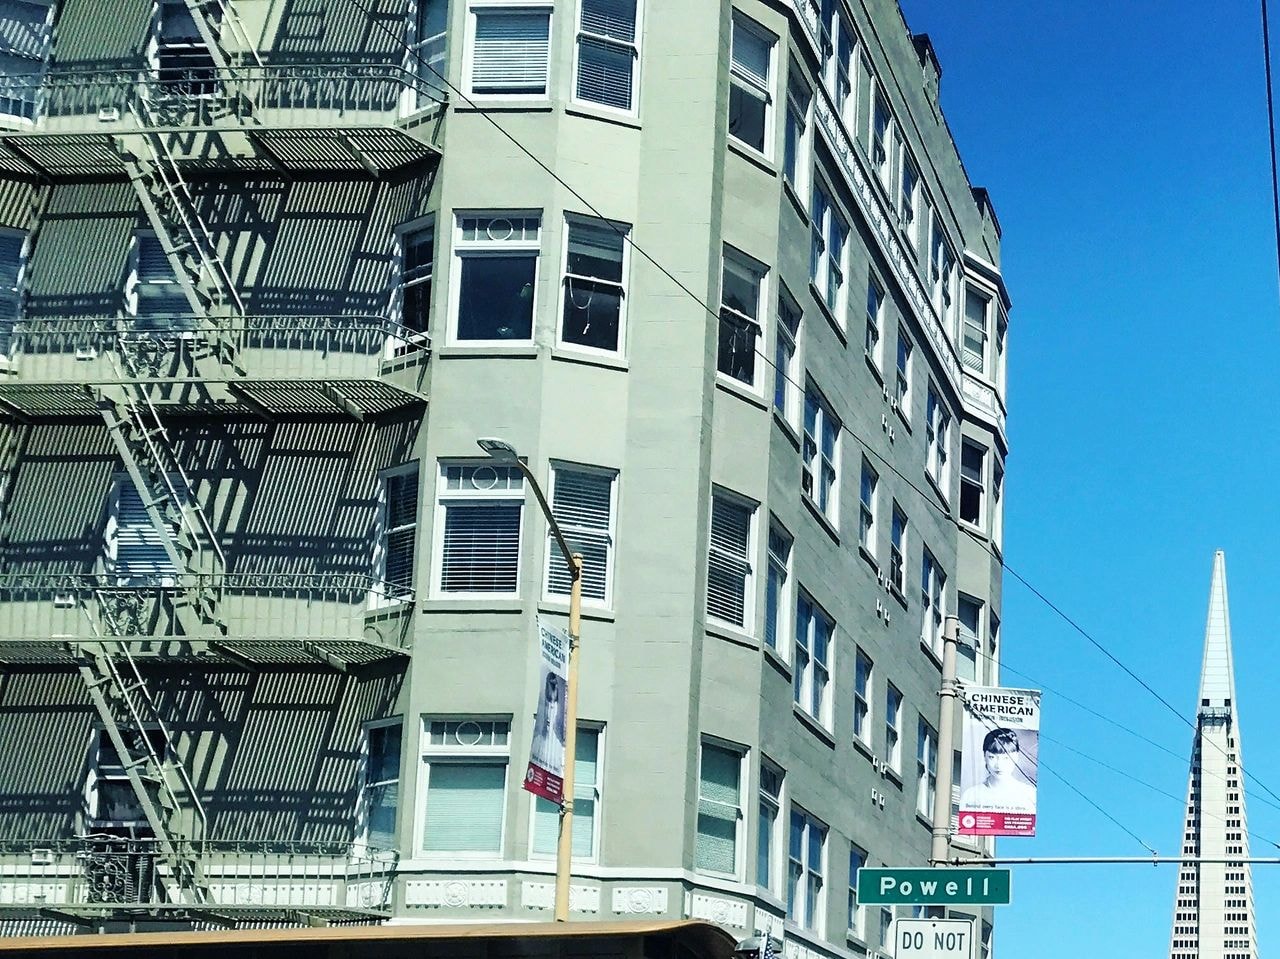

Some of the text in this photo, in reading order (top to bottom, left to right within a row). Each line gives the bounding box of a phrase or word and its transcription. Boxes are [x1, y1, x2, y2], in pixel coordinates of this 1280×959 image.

[971, 693, 1025, 705] CHINESE
[972, 703, 1034, 716] AMERICAN
[880, 876, 989, 896] Powell
[902, 931, 965, 951] DO NOT
